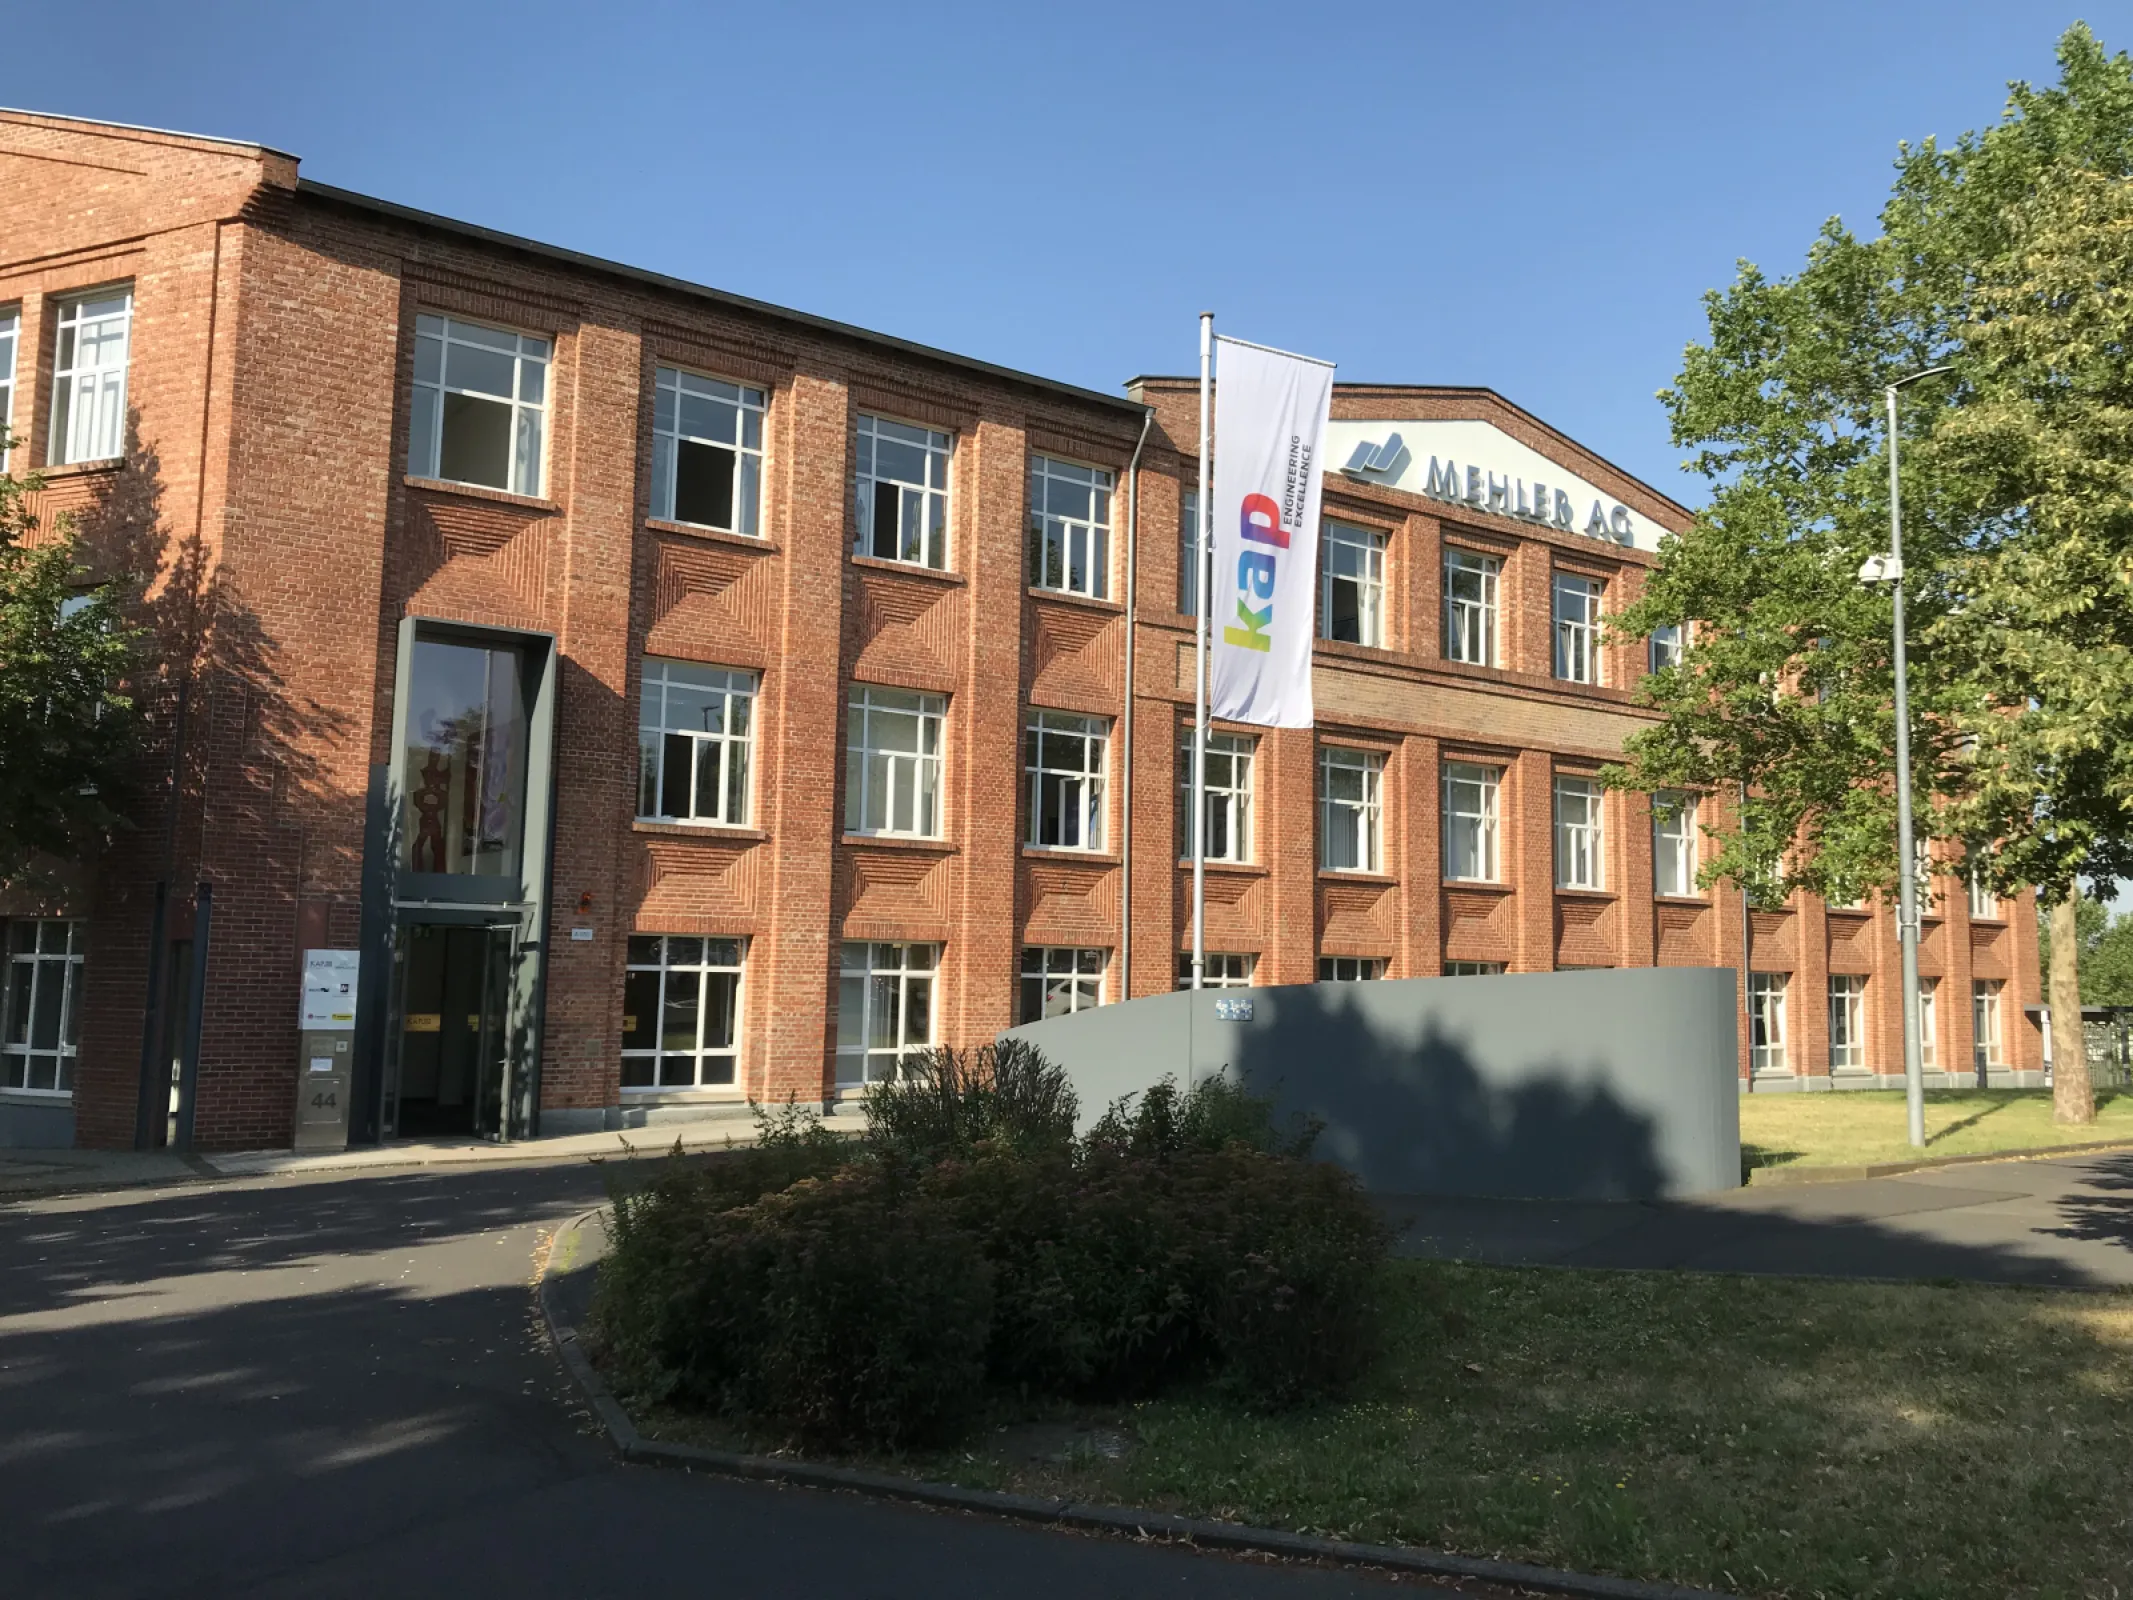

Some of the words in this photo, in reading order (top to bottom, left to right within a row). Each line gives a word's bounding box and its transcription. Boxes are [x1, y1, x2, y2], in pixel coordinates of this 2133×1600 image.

[1283, 435, 1301, 526] ENGINEERING
[1294, 444, 1312, 529] EXCELLENCE
[1424, 455, 1570, 528] MEHLER
[1585, 499, 1631, 542] AG
[1224, 492, 1291, 653] kap
[311, 1092, 337, 1109] 44
